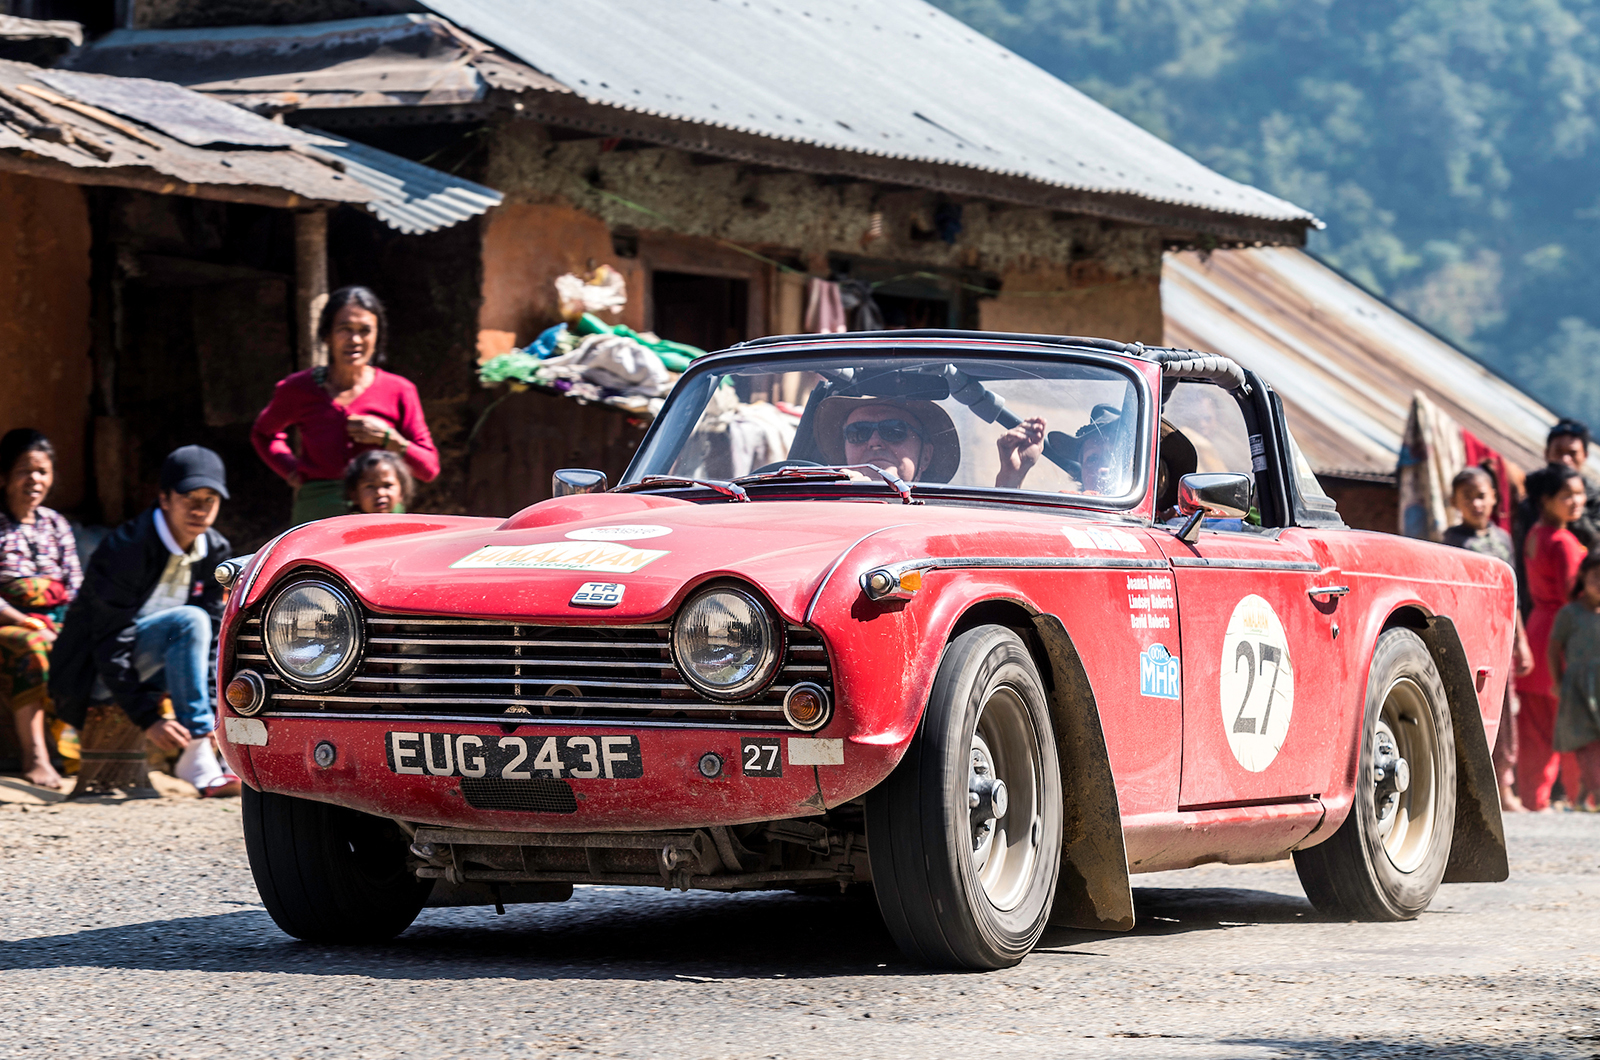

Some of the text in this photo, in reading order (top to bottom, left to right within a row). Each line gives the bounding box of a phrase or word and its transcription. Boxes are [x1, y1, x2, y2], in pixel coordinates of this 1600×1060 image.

[463, 548, 656, 567] HIMALAYAN
[589, 583, 618, 592] TR
[1147, 574, 1172, 590] Roberts
[574, 592, 619, 602] 250
[1128, 593, 1174, 612] Lindsey Roberts
[1130, 613, 1171, 629] David Roberts
[1141, 656, 1179, 696] MHR
[1232, 640, 1282, 735] 27
[391, 731, 632, 779] EUG 243F
[742, 744, 780, 772] 27
